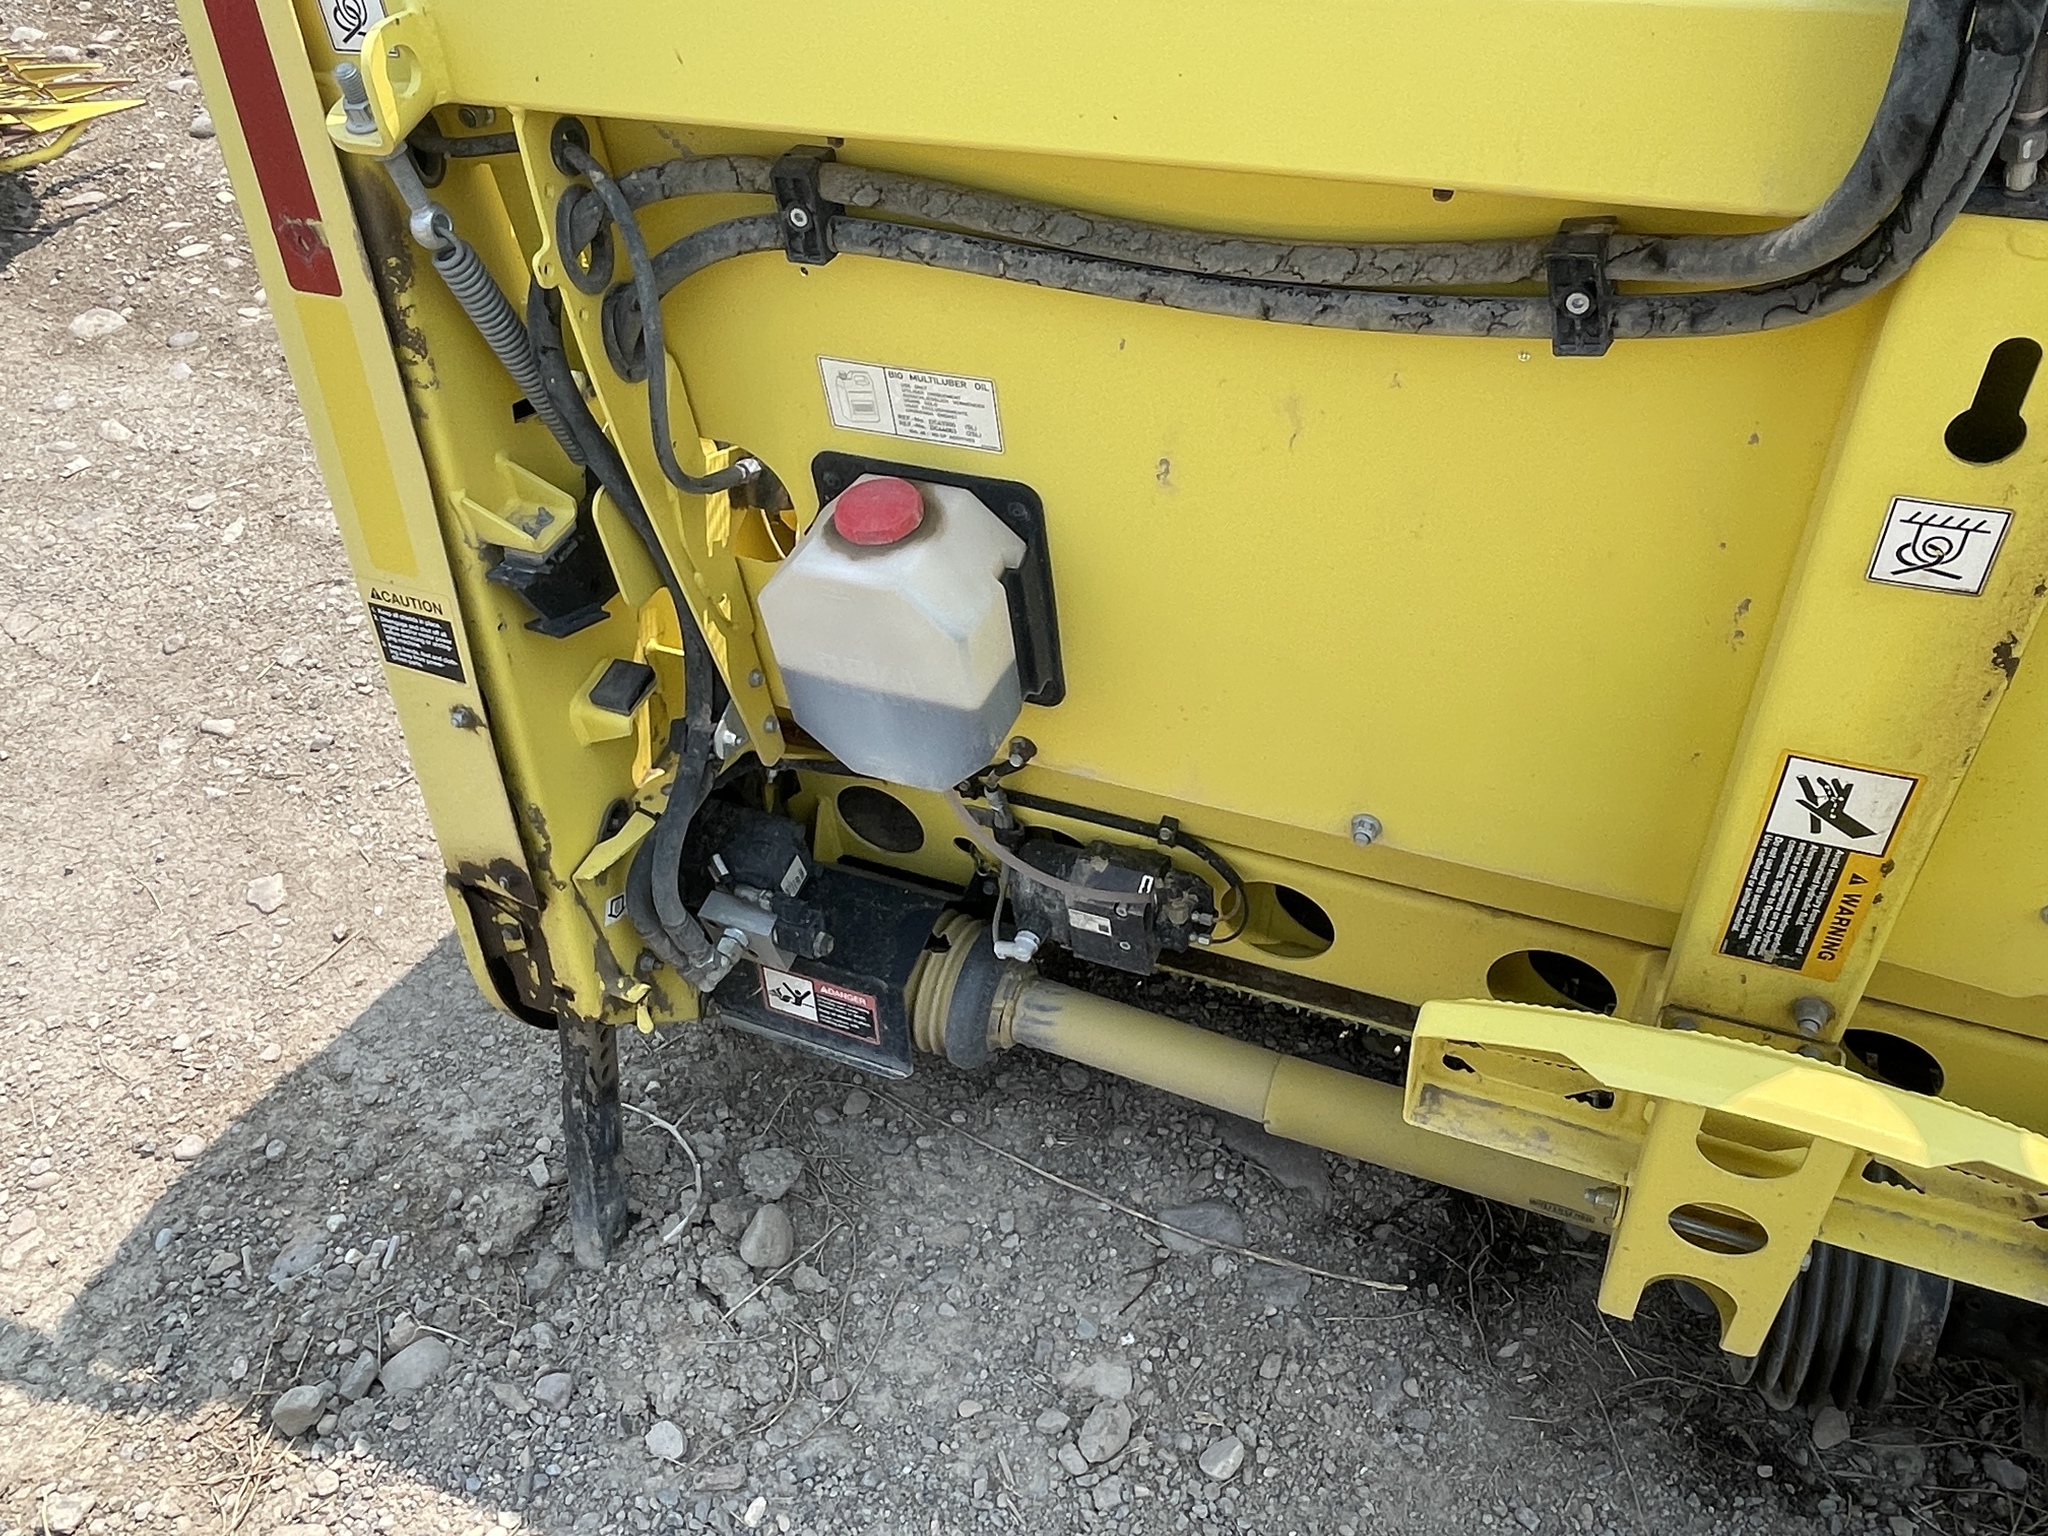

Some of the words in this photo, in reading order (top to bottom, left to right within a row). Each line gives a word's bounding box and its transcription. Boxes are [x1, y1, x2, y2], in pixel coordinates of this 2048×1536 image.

[887, 370, 903, 379] BIO
[908, 373, 967, 389] MULTILUBER
[974, 383, 989, 391] OIL
[381, 591, 442, 615] CAUTION
[1817, 894, 1861, 961] WARNING
[827, 987, 866, 1005] DANGER
